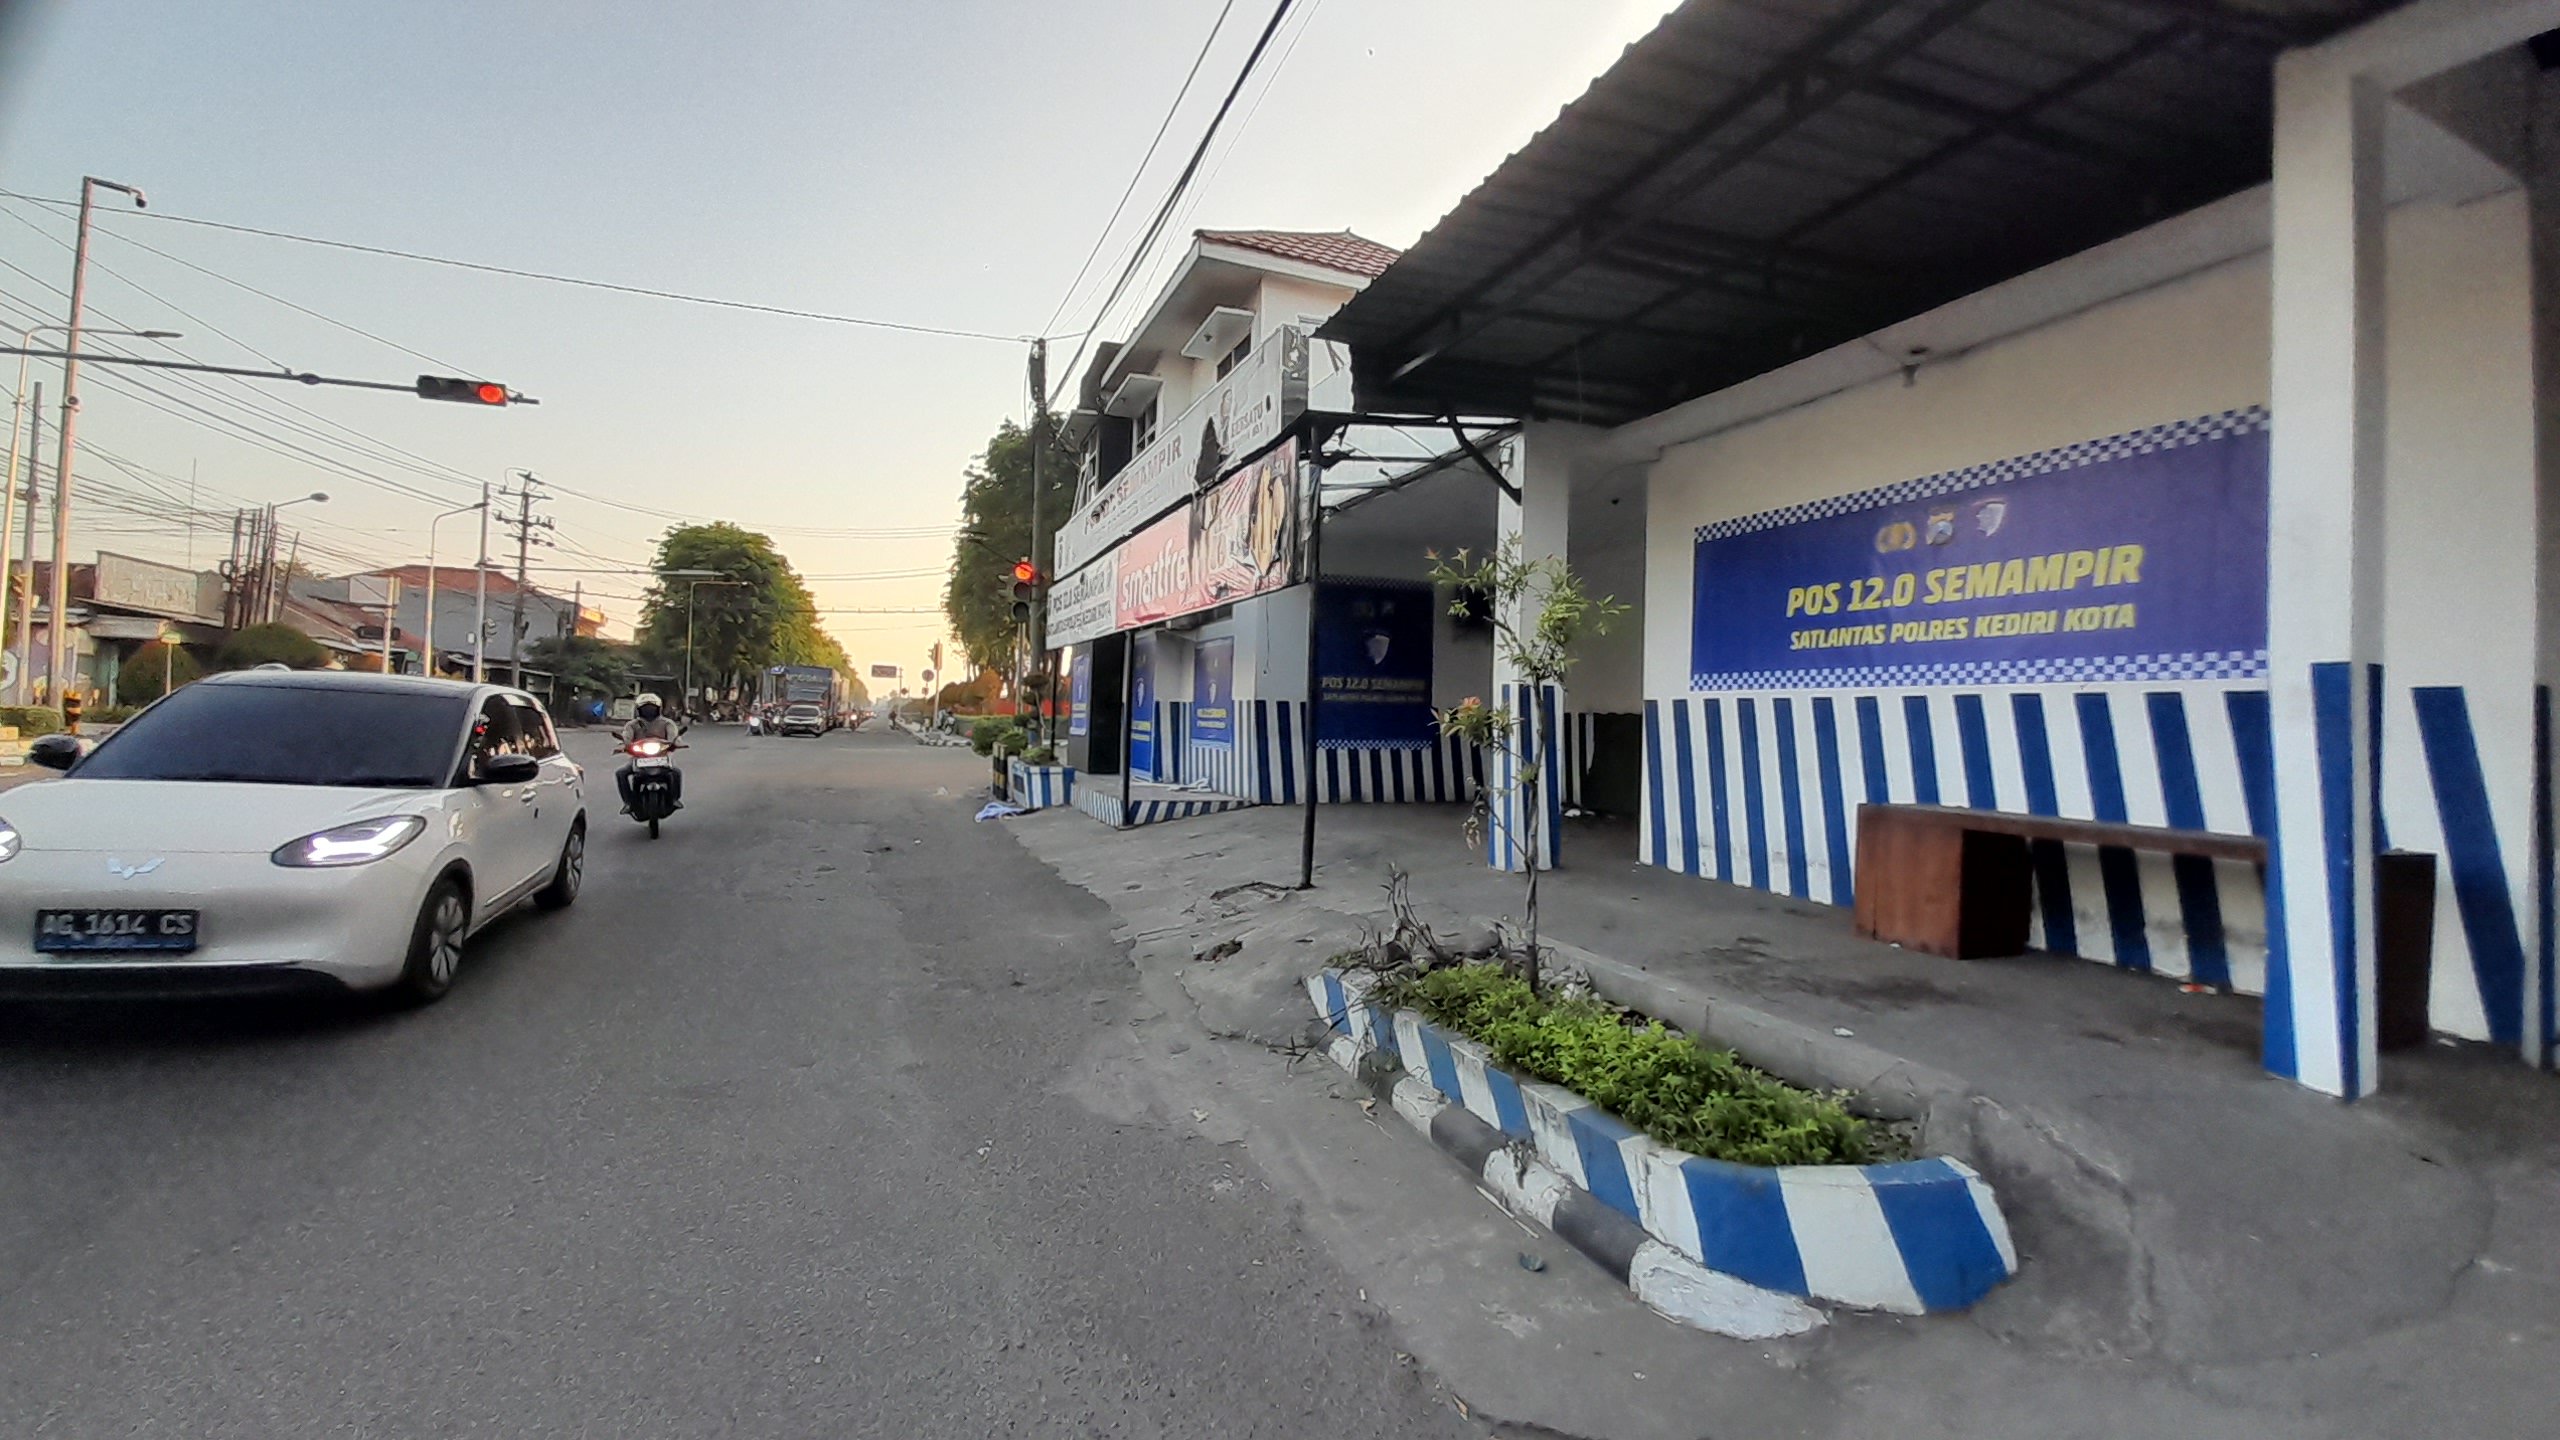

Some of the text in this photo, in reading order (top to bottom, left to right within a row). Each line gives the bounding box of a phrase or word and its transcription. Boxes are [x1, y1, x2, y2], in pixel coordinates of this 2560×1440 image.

[1786, 544, 2144, 618] POS 12.0 SEMAMPIR
[1790, 603, 2136, 651] SATLANTAS POLRES KEDIRI KOTA
[1322, 676, 1343, 689] POS
[160, 914, 193, 934] CS
